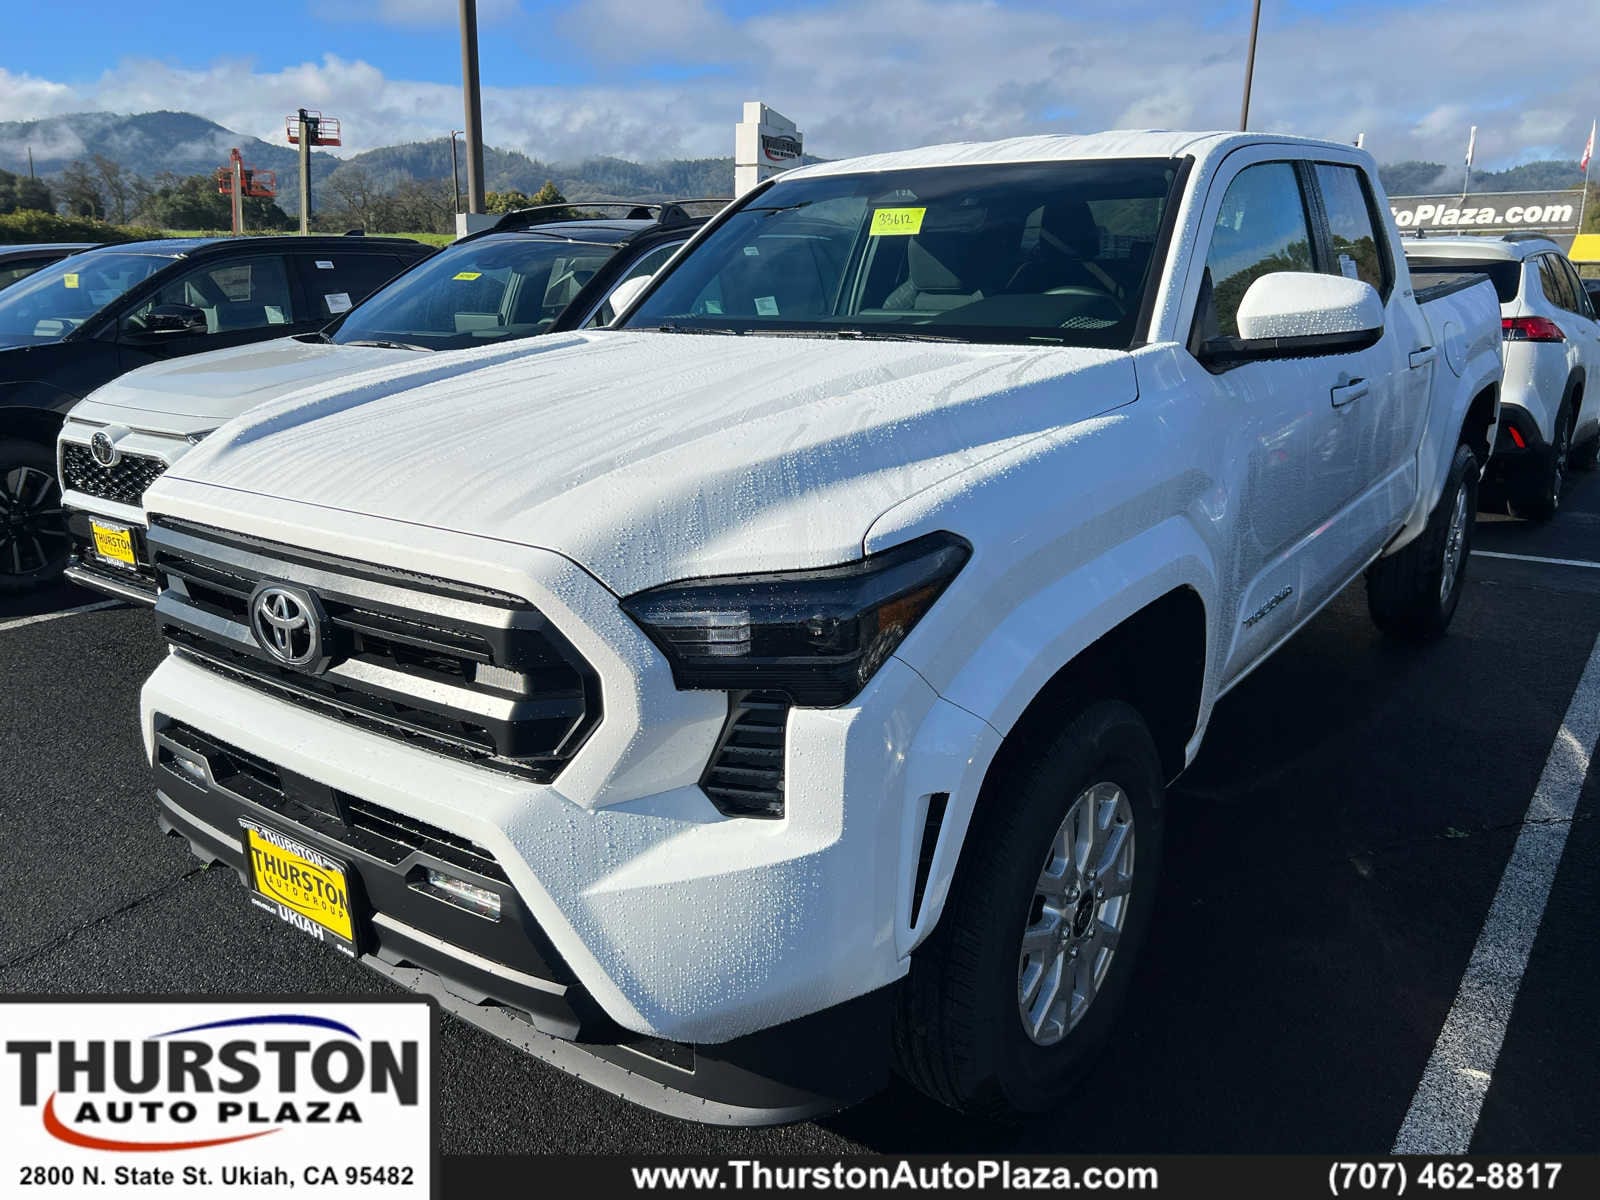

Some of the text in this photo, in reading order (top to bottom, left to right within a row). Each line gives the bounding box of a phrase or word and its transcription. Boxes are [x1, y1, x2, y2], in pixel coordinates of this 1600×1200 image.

[879, 212, 913, 225] 33612
[264, 831, 322, 867] THURSTON
[269, 876, 298, 897] AUTO
[304, 892, 344, 919] GROUP
[278, 904, 324, 941] UKIAH
